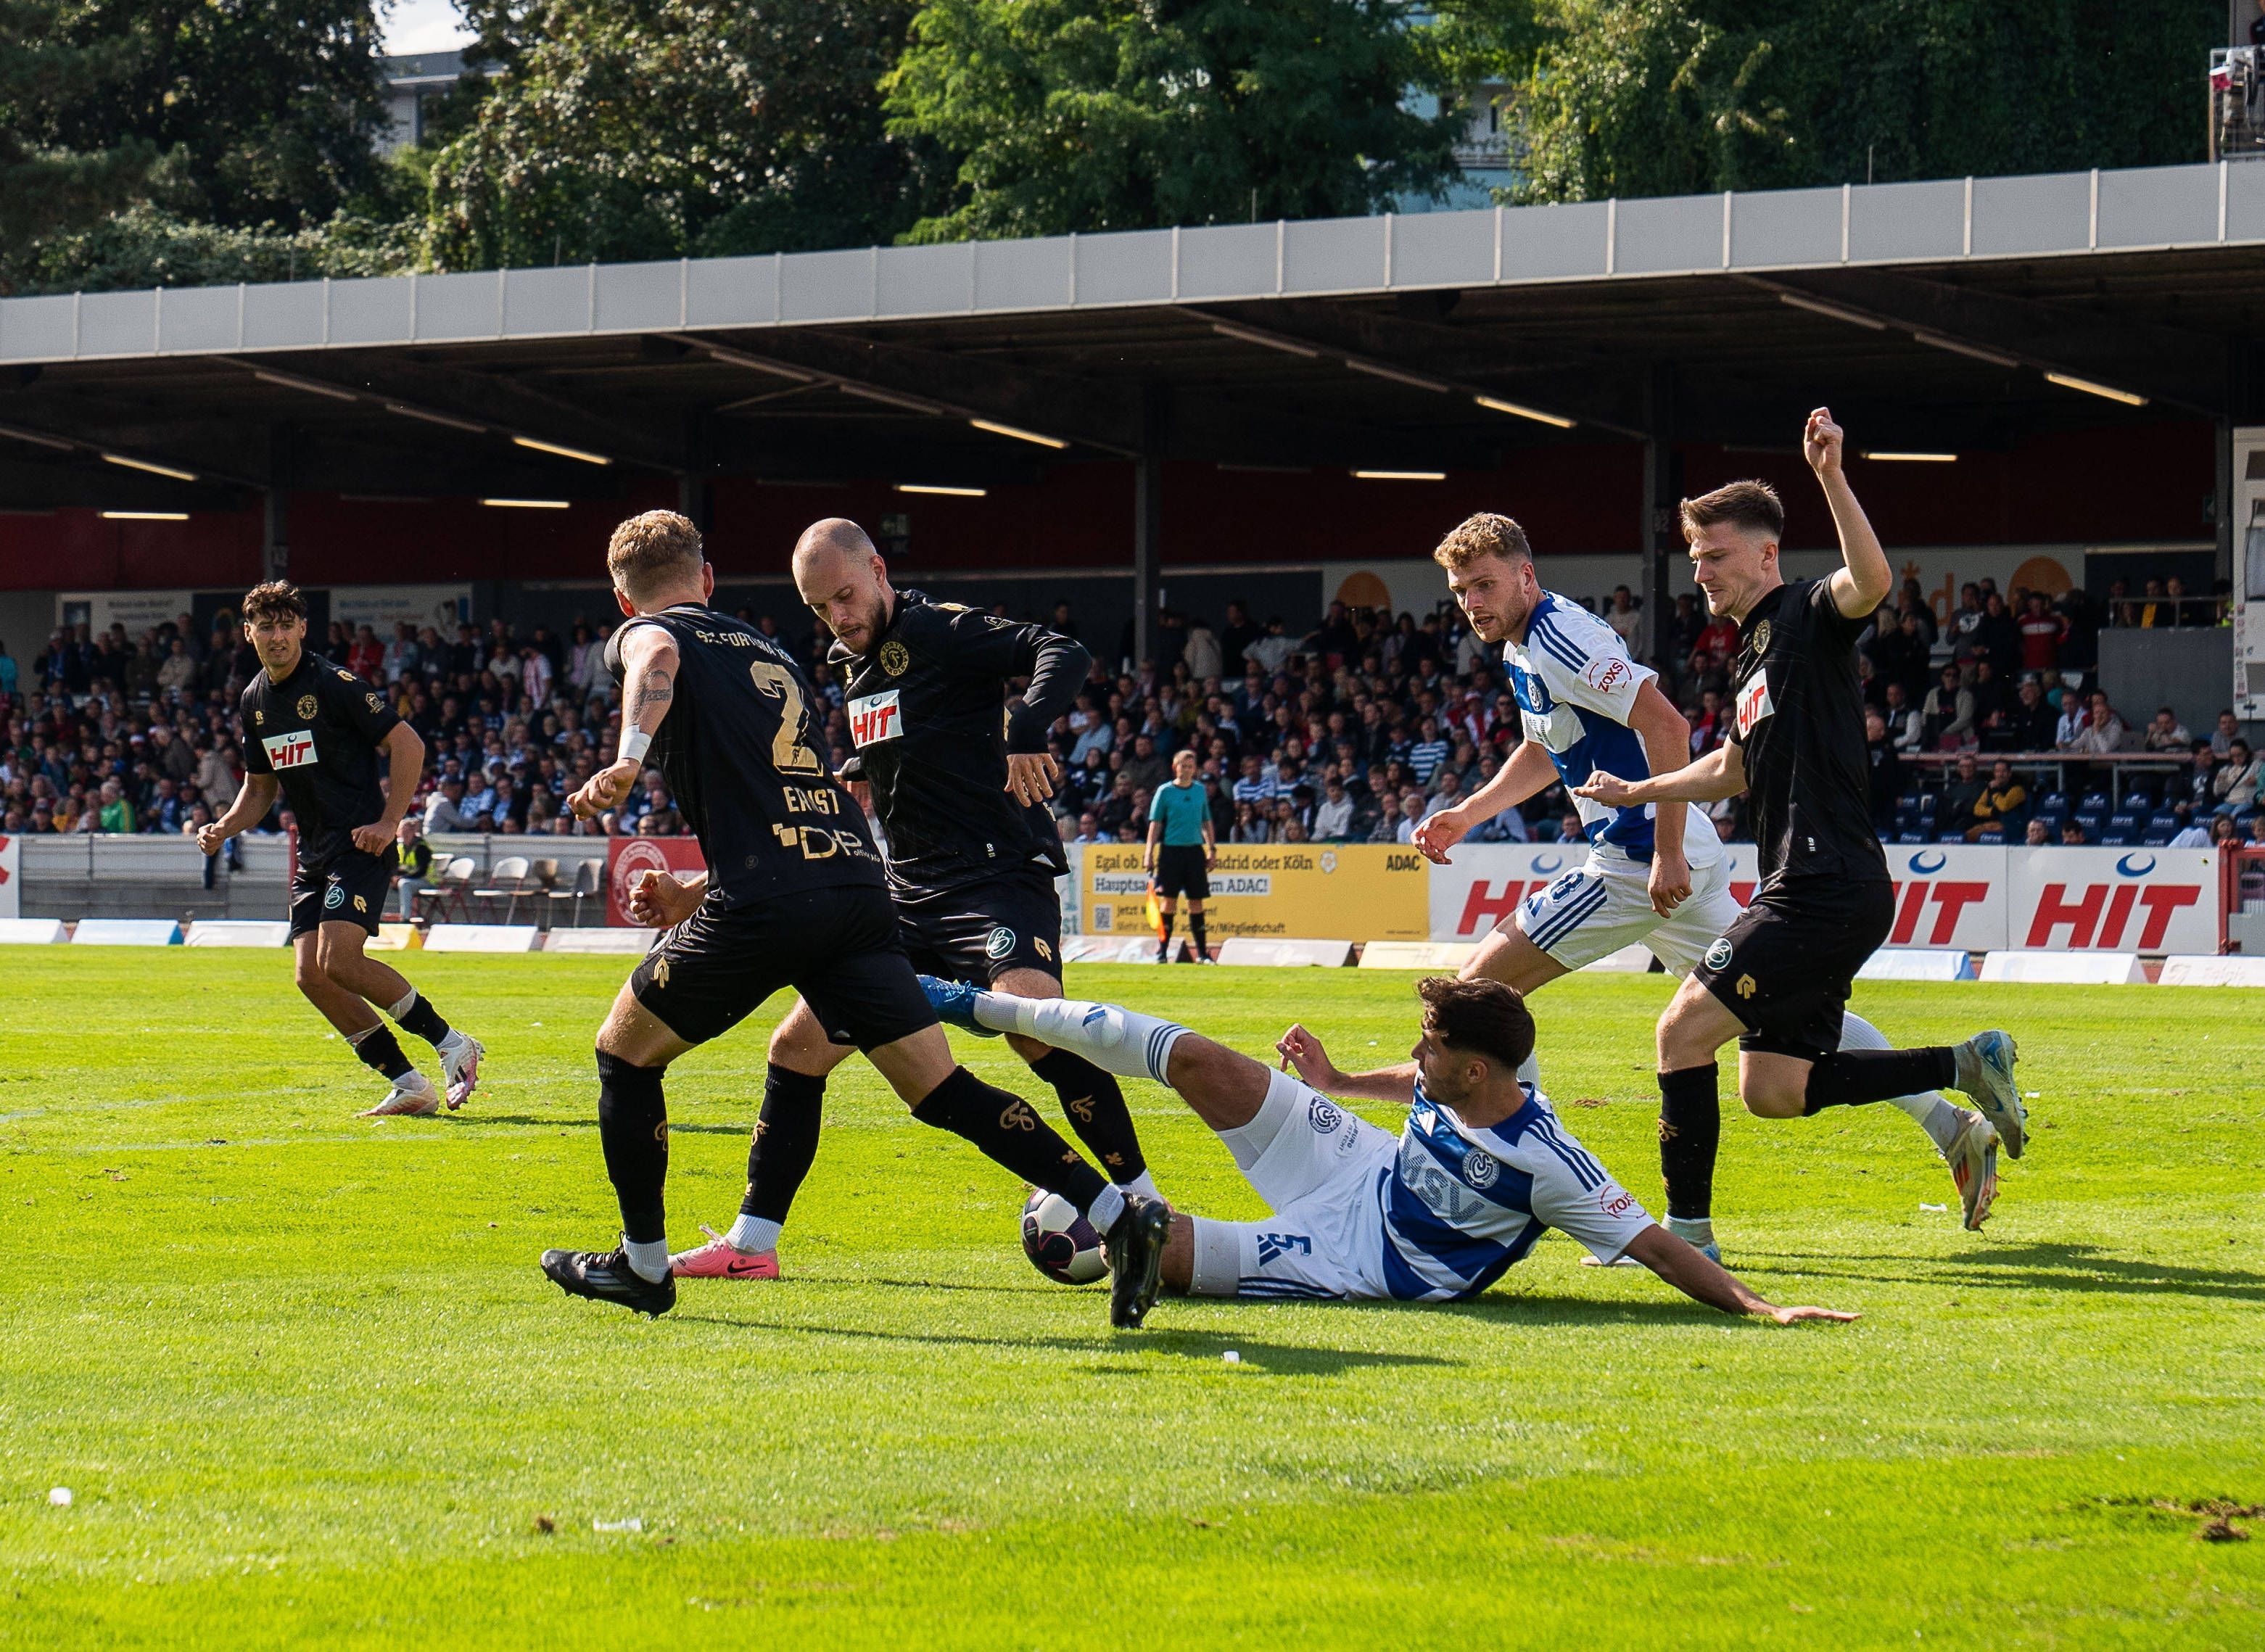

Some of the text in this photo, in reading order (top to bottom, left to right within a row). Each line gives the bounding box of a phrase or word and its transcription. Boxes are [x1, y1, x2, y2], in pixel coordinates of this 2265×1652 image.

[1598, 661, 1624, 693] ZOXS
[749, 661, 824, 777] 2
[1739, 684, 1766, 732] HIT
[853, 704, 898, 746] HIT
[269, 740, 313, 769] HIT
[1095, 853, 1313, 873] Egal ob adrid oder Köln
[1386, 854, 1421, 872] ADAC
[1226, 878, 1268, 893] ADAC!
[1889, 881, 1990, 945] IT
[2025, 883, 2202, 949] HIT
[1266, 1233, 1312, 1257] 5
